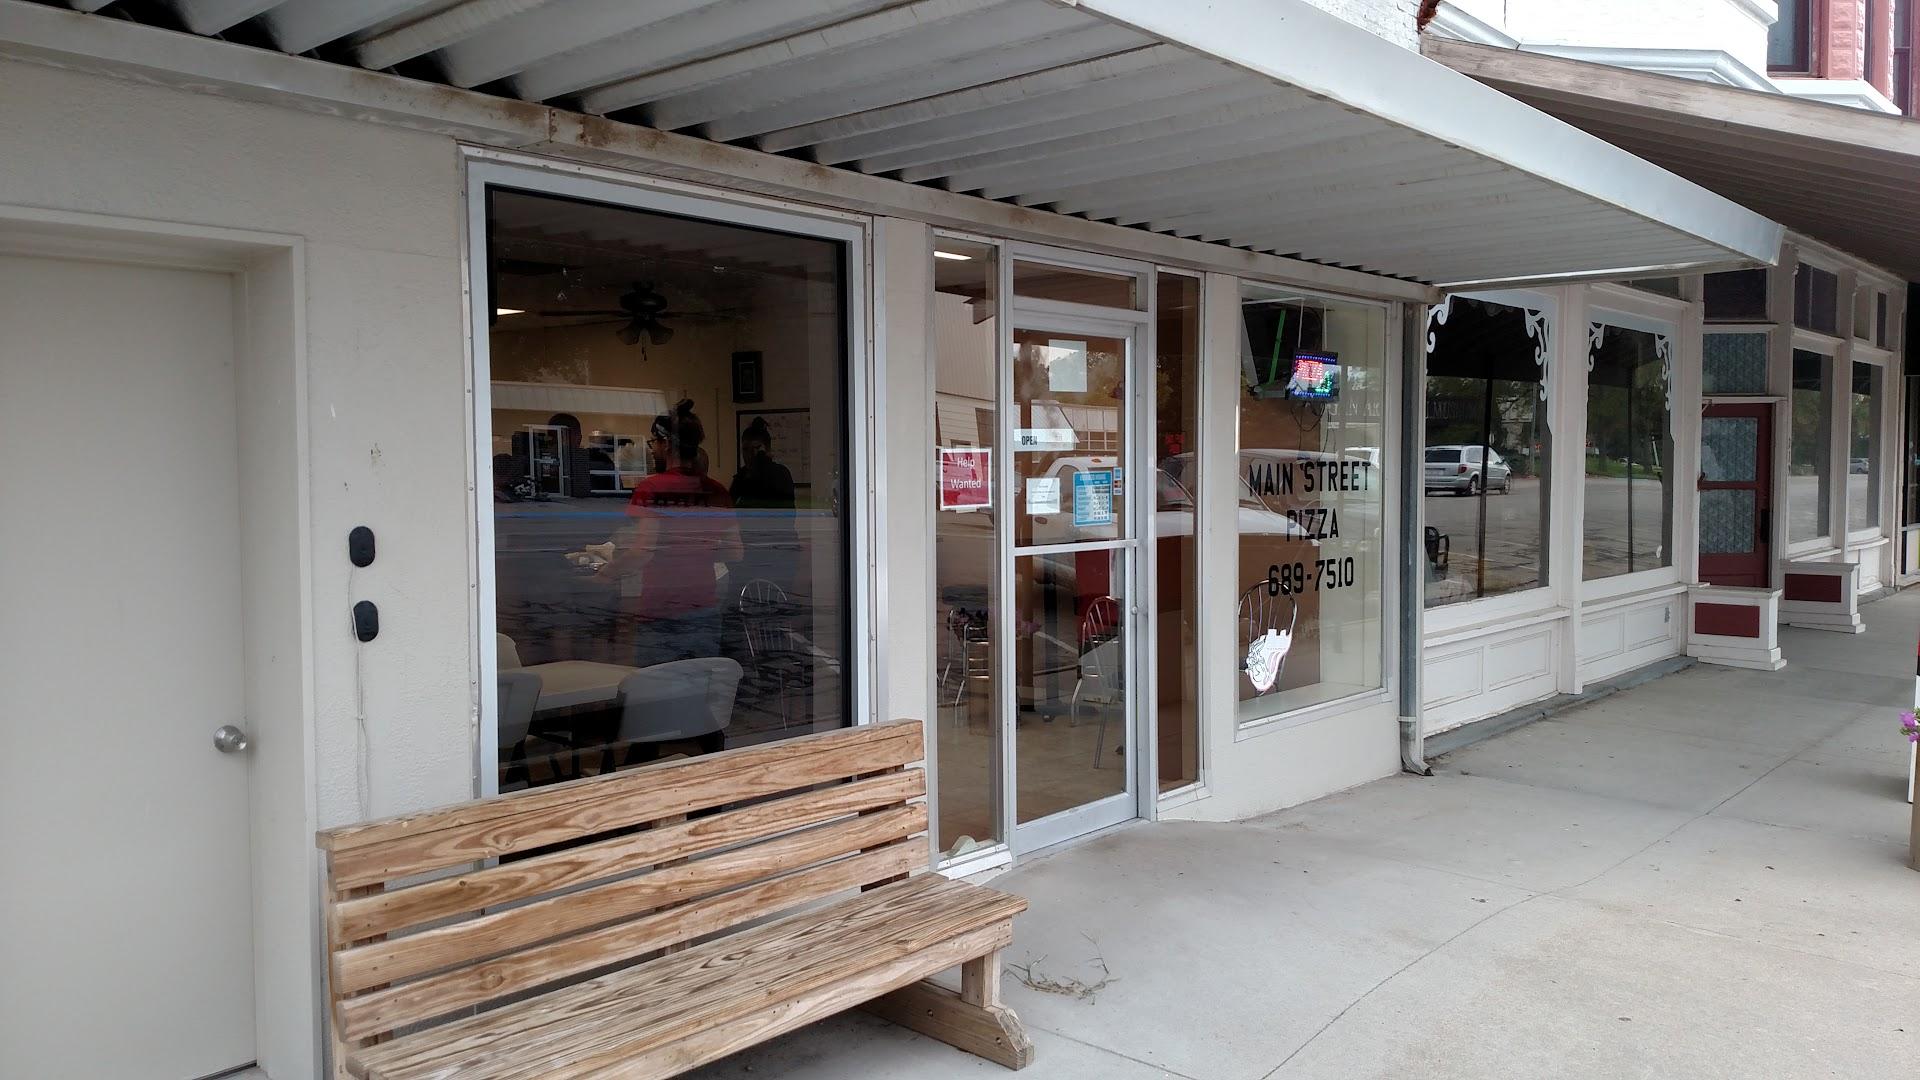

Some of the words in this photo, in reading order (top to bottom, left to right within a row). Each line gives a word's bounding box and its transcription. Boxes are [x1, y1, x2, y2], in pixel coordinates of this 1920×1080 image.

[1021, 435, 1038, 446] OPEN
[957, 456, 976, 470] Help
[950, 477, 982, 489] Wanted
[1249, 463, 1294, 497] MAIN
[1303, 461, 1371, 493] STREET
[1286, 508, 1339, 542] PIZZA
[1268, 557, 1354, 597] 689-7510
